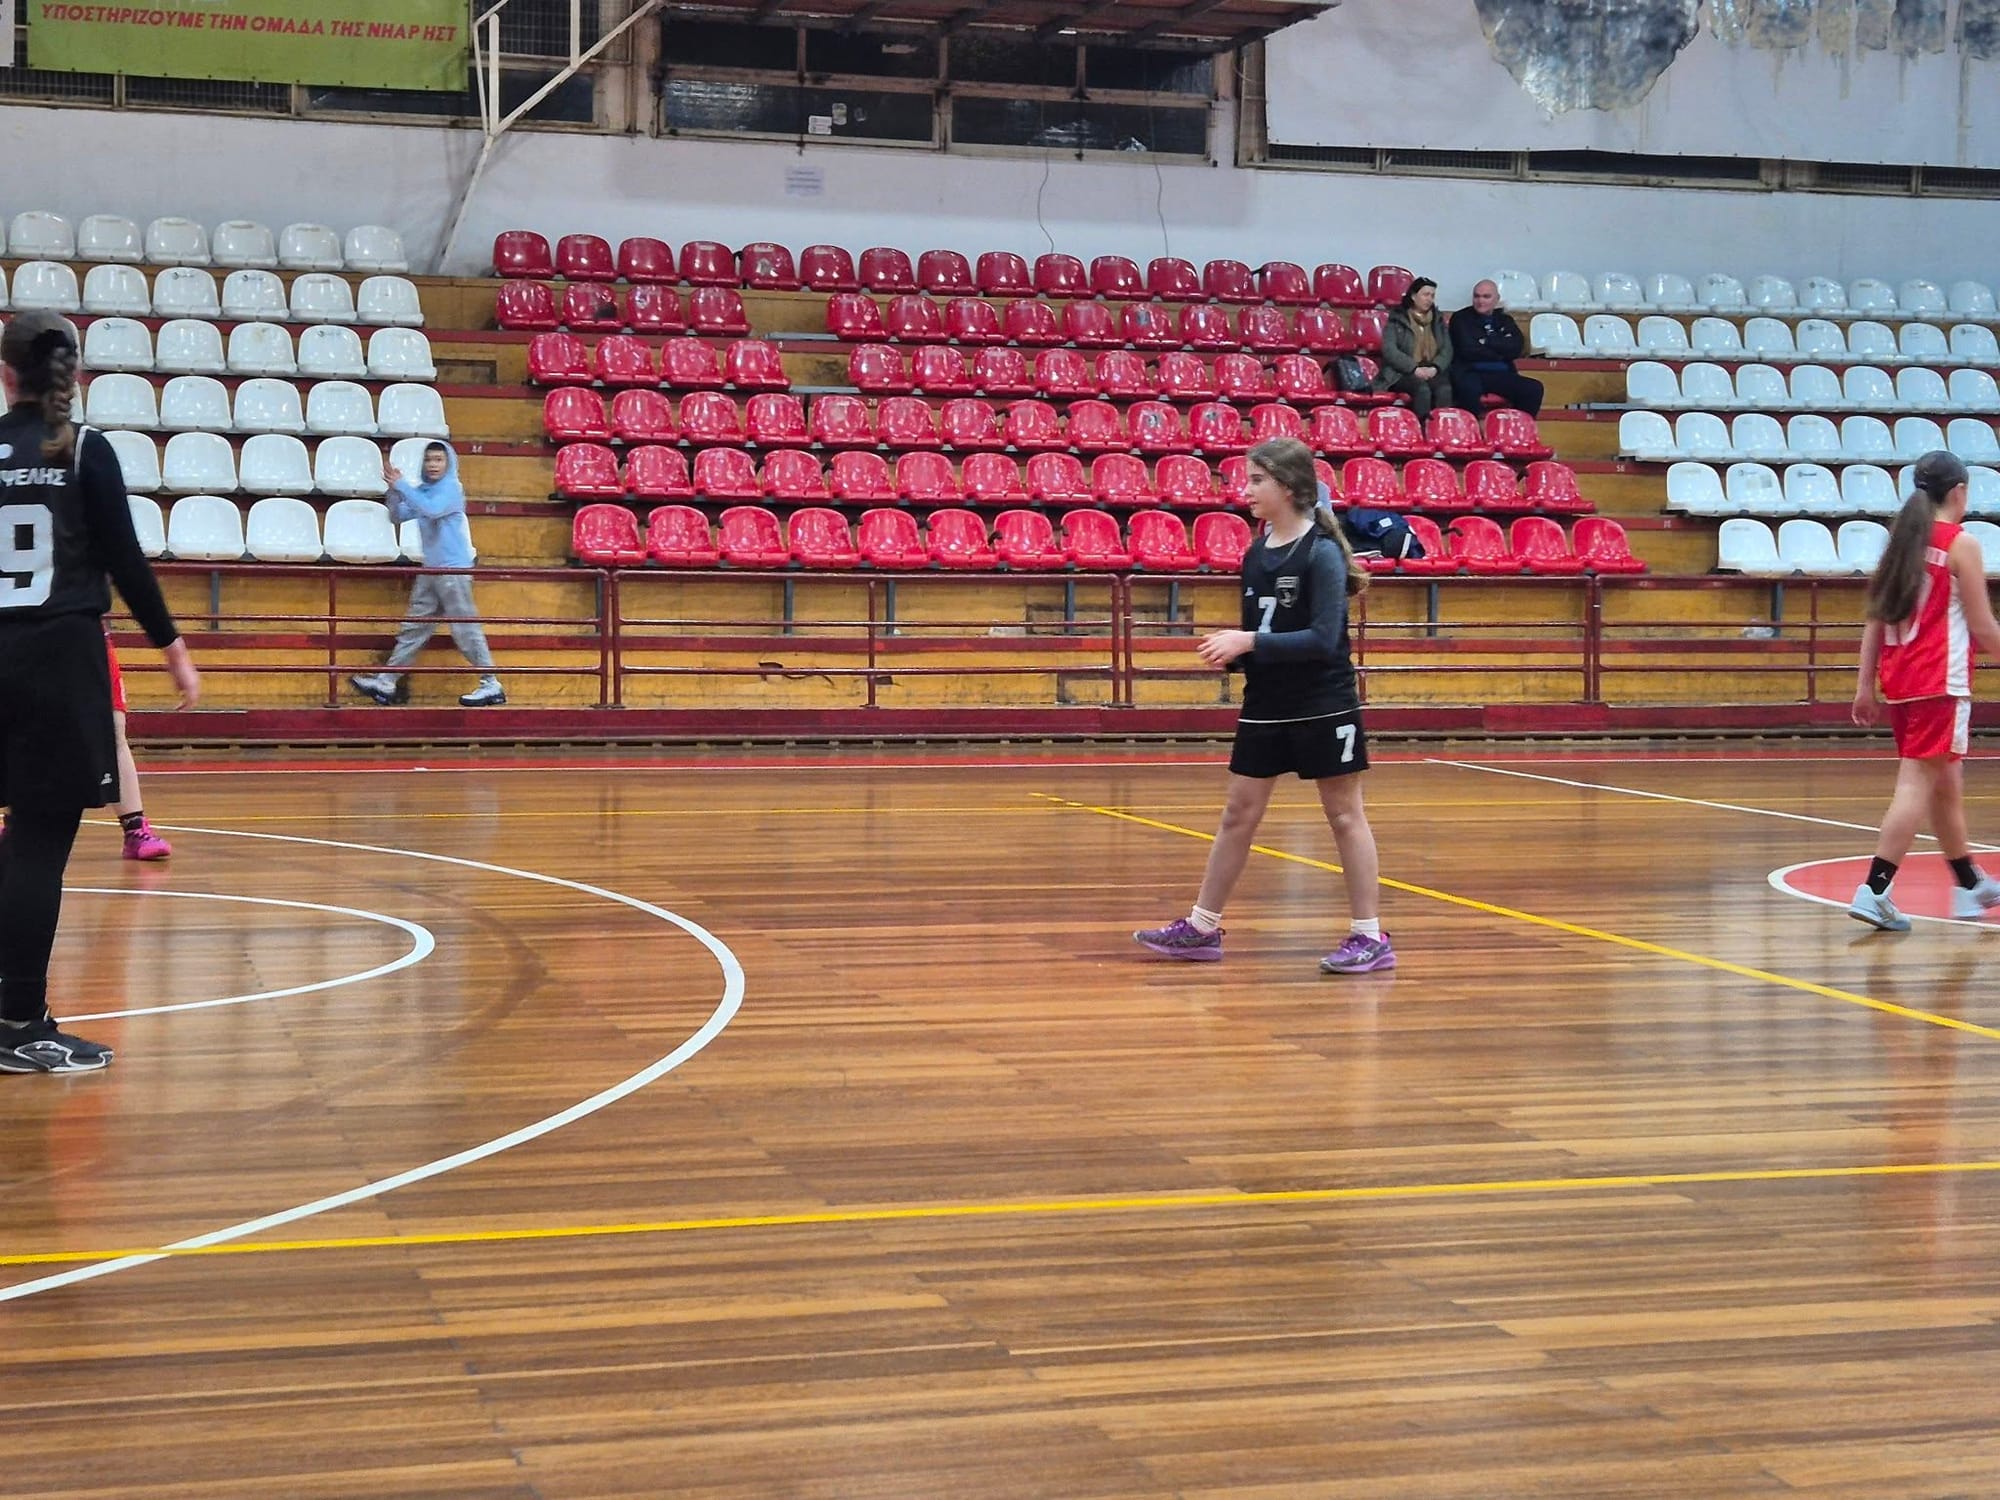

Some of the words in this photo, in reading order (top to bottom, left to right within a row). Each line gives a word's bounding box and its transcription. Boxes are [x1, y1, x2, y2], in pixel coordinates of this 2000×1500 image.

[41, 4, 206, 28] ΥΠΟΣΤΗΡΙΖΟΥΜΕ
[210, 14, 248, 30] ΤΗΝ
[251, 16, 325, 35] ΟΜΑΔΑ
[331, 20, 364, 37] ΤΗΣ
[0, 504, 54, 607] 9
[1258, 596, 1277, 633] 7
[1335, 723, 1357, 763] 7
